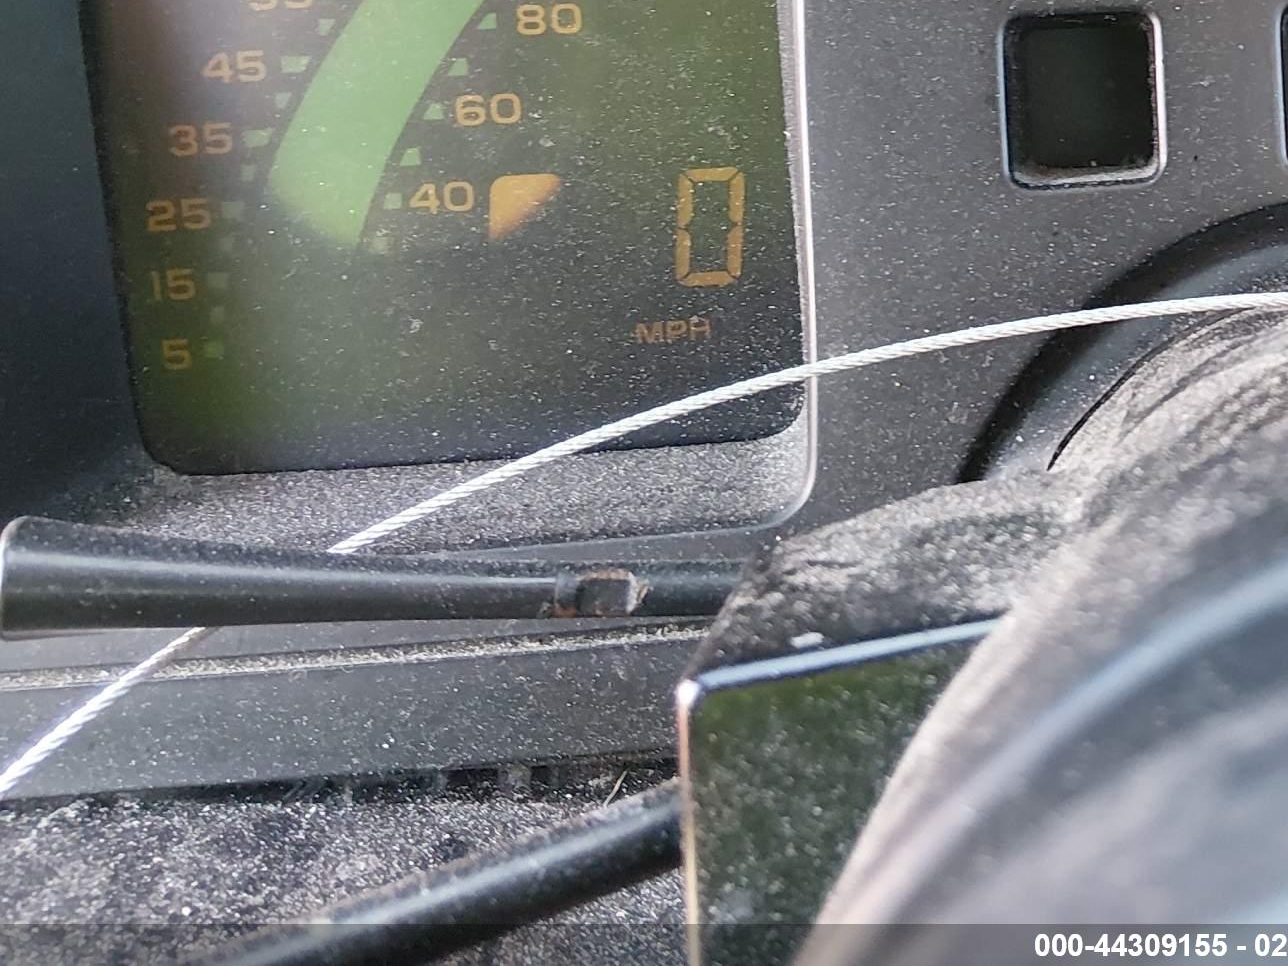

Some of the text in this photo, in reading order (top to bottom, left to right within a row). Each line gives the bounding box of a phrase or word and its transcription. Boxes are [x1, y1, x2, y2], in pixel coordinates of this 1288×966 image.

[516, 3, 583, 35] 80
[202, 51, 268, 83] 45
[454, 94, 523, 126] 60
[168, 125, 233, 157] 35
[409, 182, 475, 214] 40
[146, 199, 211, 231] 25
[674, 166, 746, 288] 0
[152, 268, 195, 301] 15
[635, 319, 711, 345] MPH
[161, 338, 192, 370] 5
